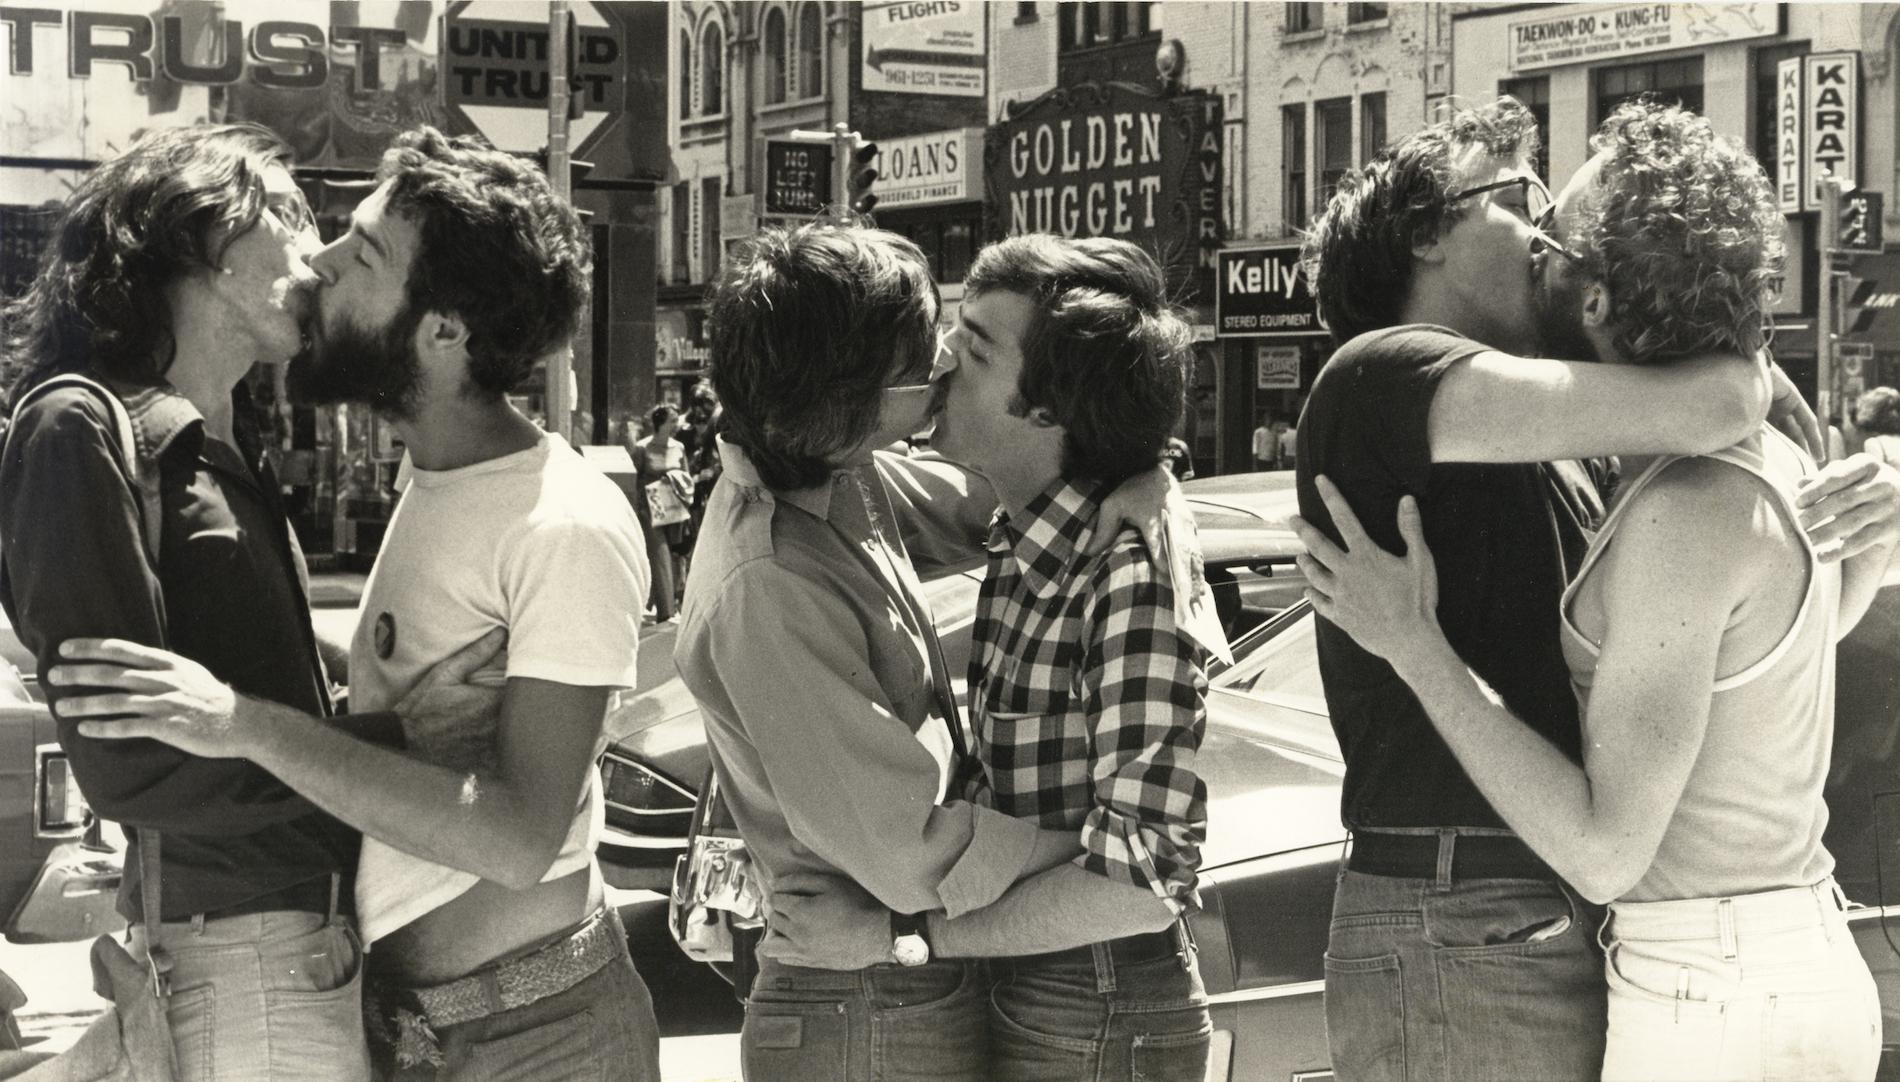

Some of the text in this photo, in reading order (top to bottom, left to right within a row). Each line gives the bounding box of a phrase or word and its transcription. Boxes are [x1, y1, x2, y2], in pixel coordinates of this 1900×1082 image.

[887, 2, 961, 22] FLIGHTS
[1516, 4, 1671, 43] TAEKWON-DO KUNG-FU
[0, 6, 407, 92] TRUST
[452, 67, 613, 103] TRUT
[1010, 113, 1162, 179] GOLDEN
[1782, 70, 1797, 202] KARATE
[1815, 64, 1846, 200] KARAT
[776, 170, 816, 188] LEFT
[785, 151, 808, 168] NO
[876, 140, 959, 182] LOANS
[878, 187, 921, 204] OUSEHOLD
[1009, 175, 1161, 238] NUGGET
[1200, 102, 1219, 269] TAVERN
[1228, 257, 1300, 299] Kelly
[1224, 313, 1312, 329] STEREO EQUIPMENT
